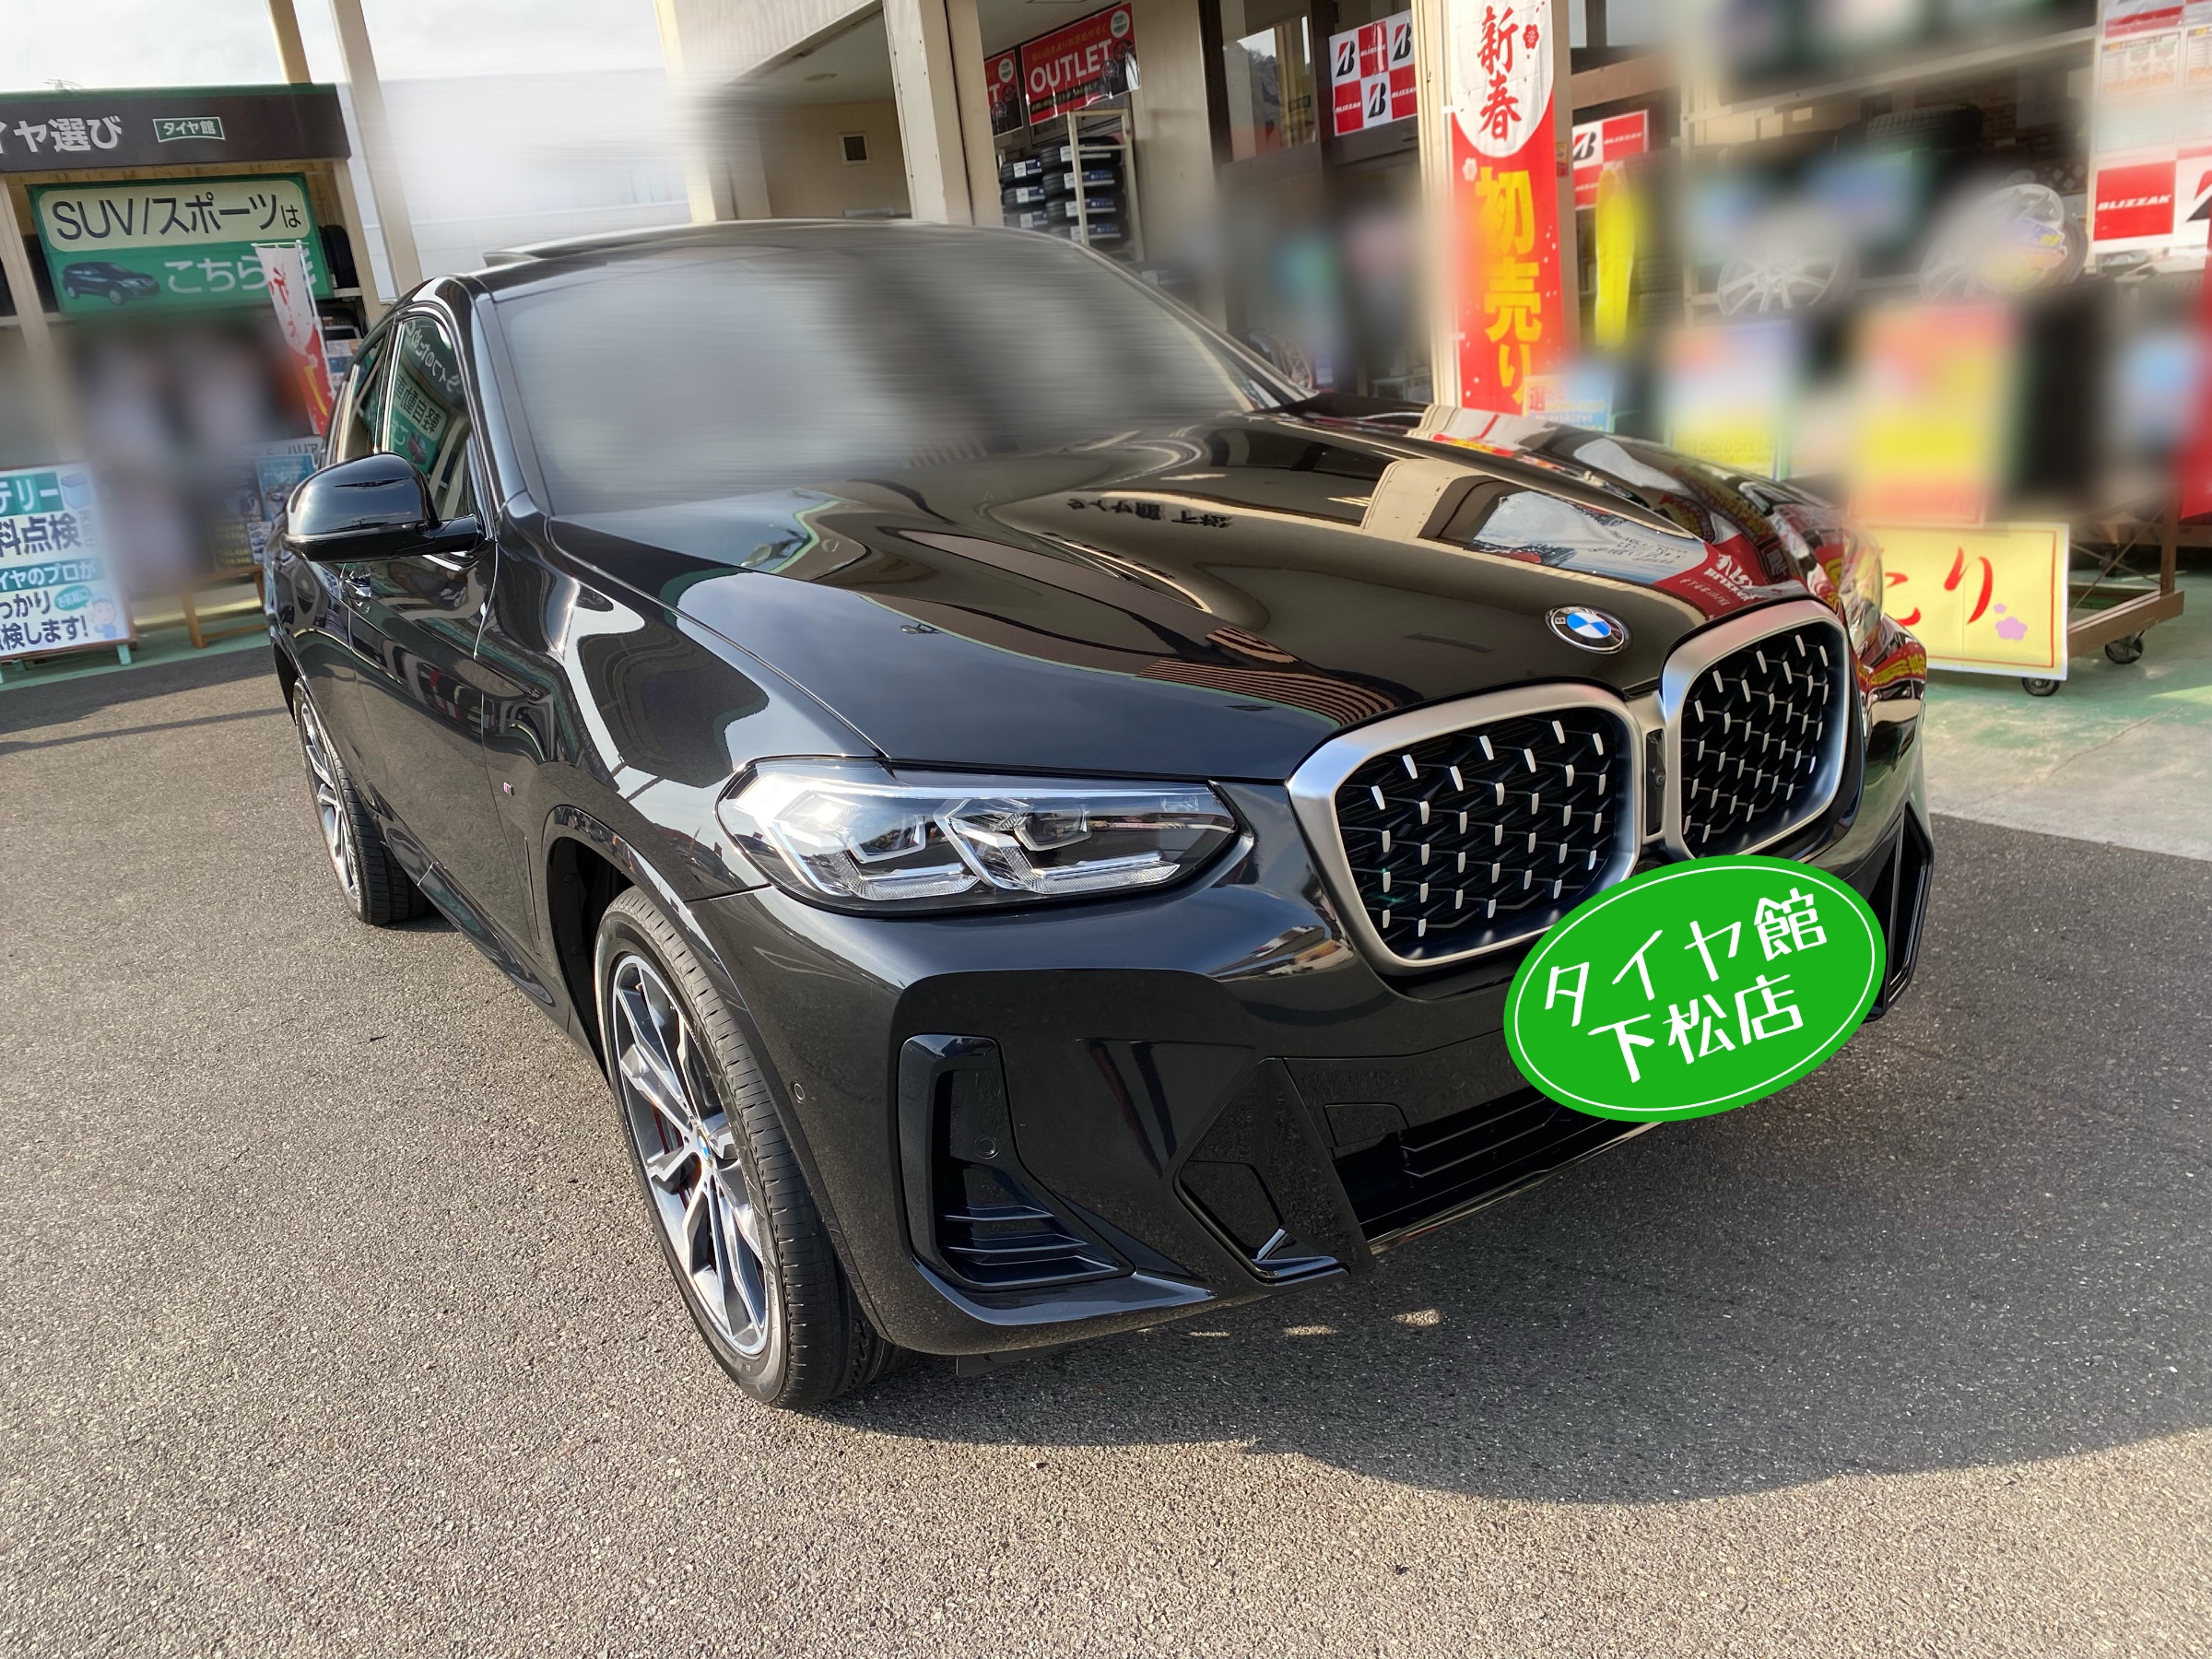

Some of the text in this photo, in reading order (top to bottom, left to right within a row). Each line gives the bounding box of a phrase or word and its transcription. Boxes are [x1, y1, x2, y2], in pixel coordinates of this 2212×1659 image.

[1030, 38, 1112, 93] OUTLET
[1477, 6, 1522, 143] 新春
[0, 115, 122, 154] ヤ選び
[163, 120, 217, 135] タイヤ館
[52, 191, 301, 241] SUV/スポーツは
[2097, 194, 2171, 211] BLIZZAK
[1475, 166, 1543, 406] 初売り
[0, 615, 88, 651] 検します!
